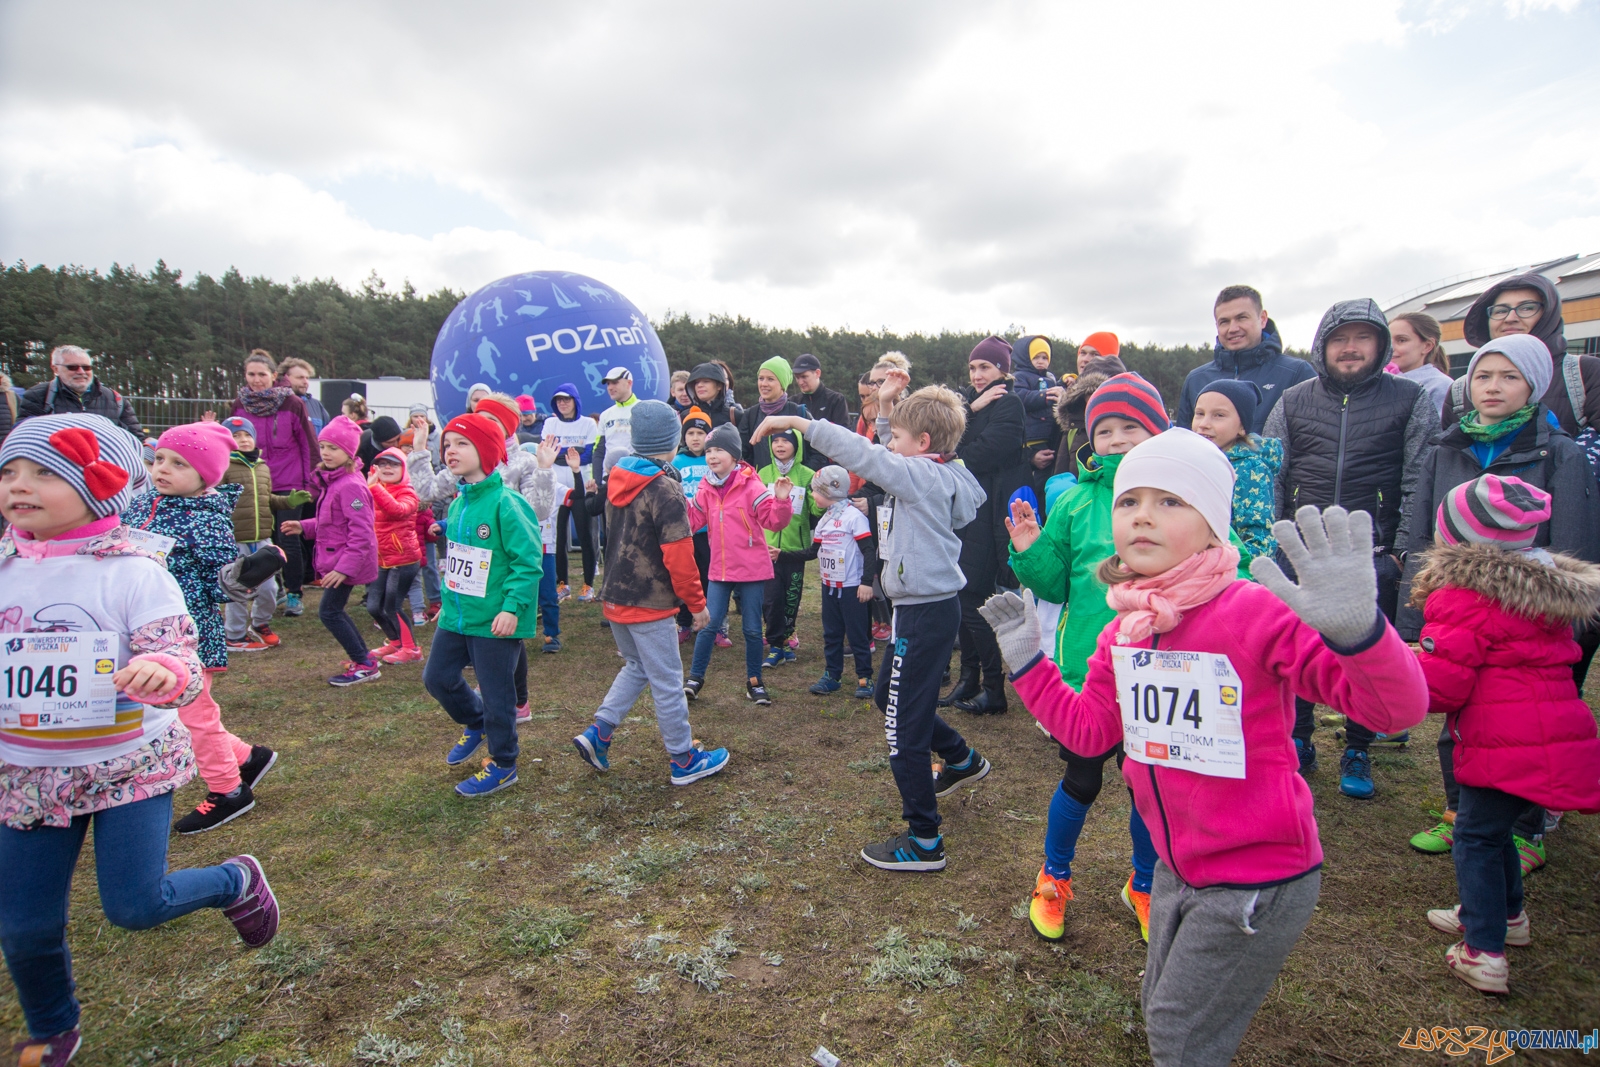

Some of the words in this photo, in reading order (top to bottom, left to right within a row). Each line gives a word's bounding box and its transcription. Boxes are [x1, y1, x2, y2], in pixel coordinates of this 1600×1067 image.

[448, 555, 473, 578] 1075
[820, 557, 836, 570] 1078
[1155, 651, 1200, 662] UNIWERSYTECKA
[4, 664, 78, 698] 1046
[57, 701, 88, 710] 10KM
[885, 655, 903, 756] CALIFORNIA
[1131, 683, 1202, 729] 1074
[1125, 723, 1138, 735] 5KM
[1185, 734, 1214, 747] 10KM
